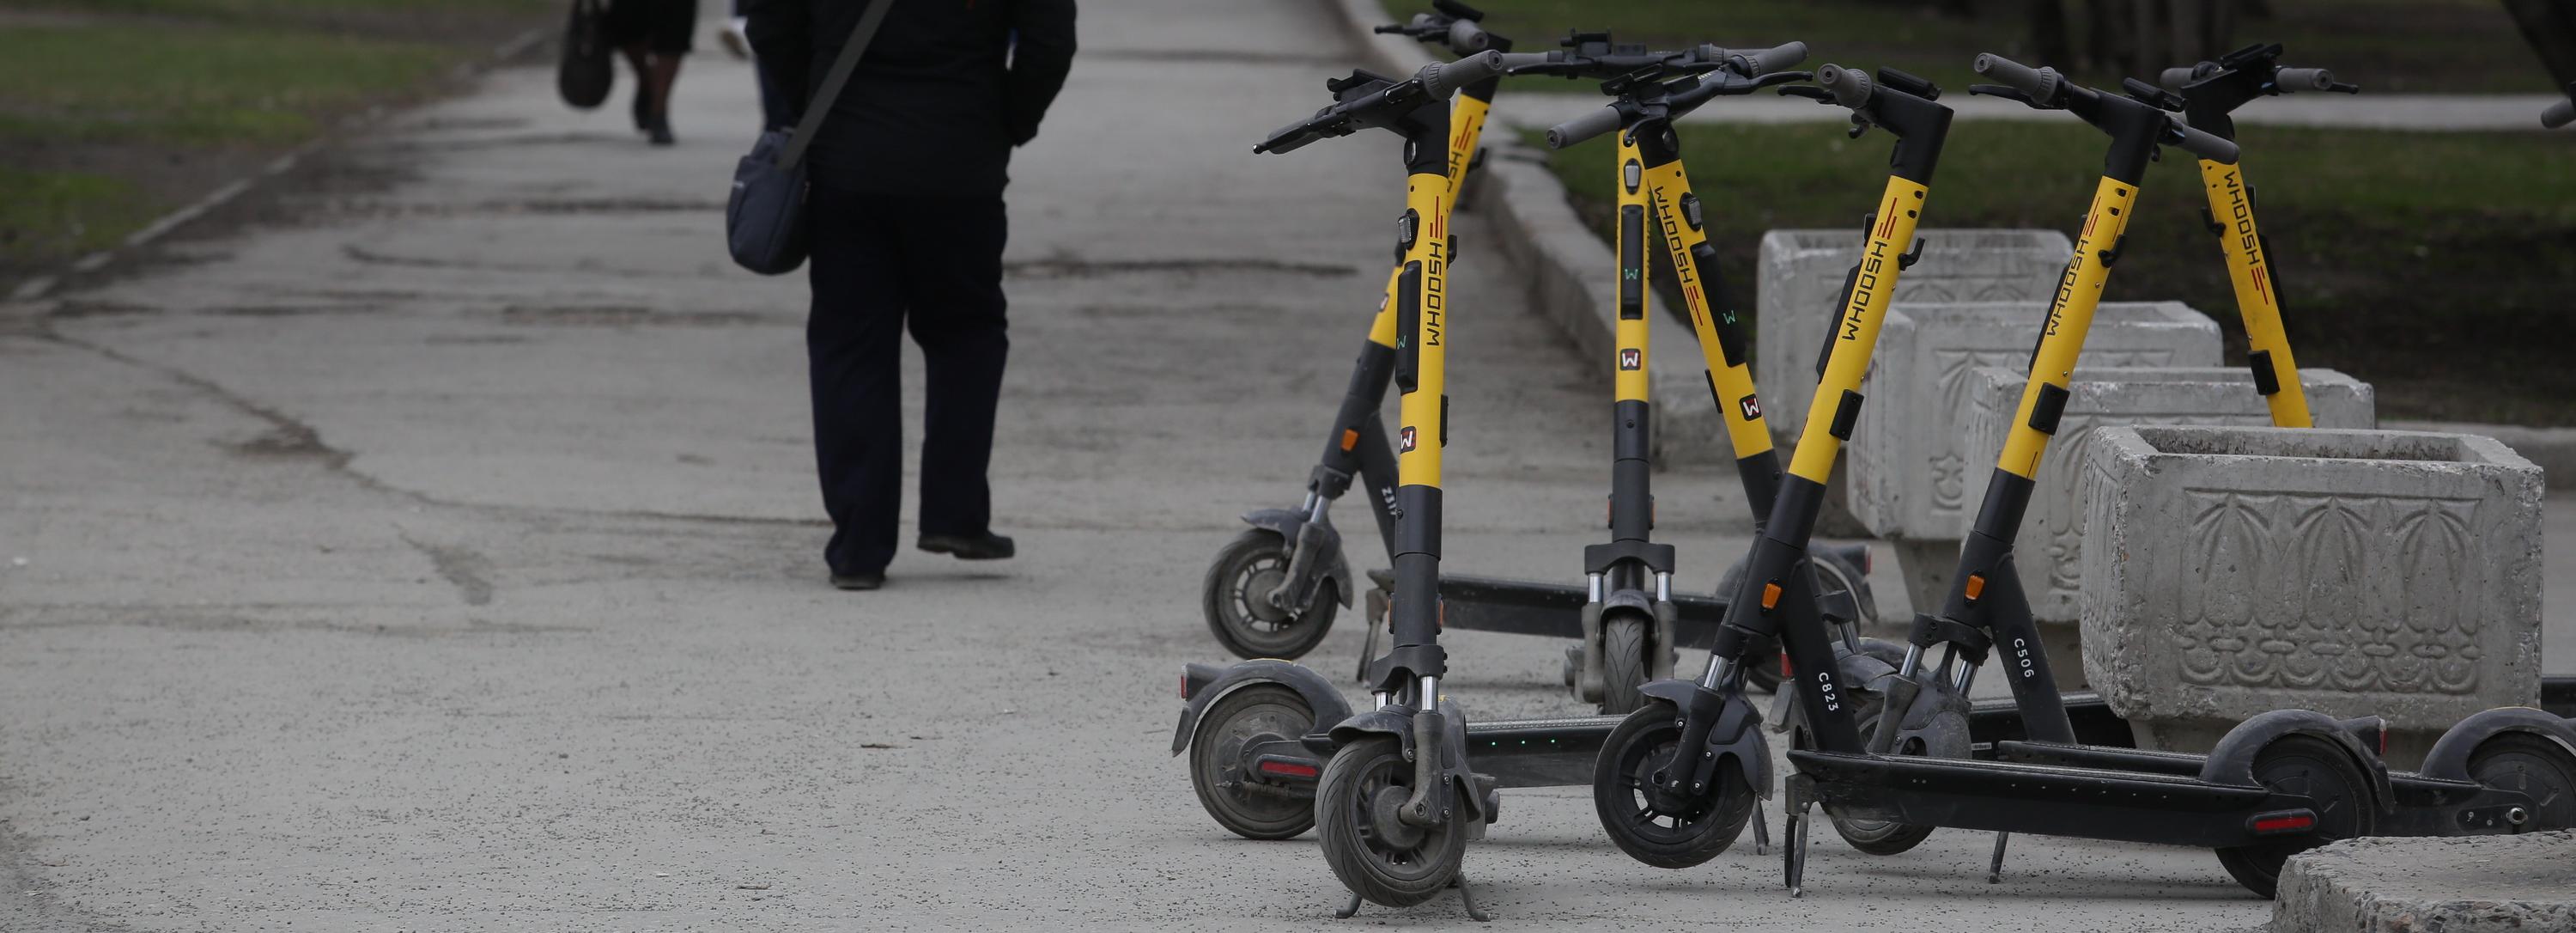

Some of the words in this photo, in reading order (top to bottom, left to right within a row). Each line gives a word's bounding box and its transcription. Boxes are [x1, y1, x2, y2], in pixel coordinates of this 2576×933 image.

[1654, 186, 1693, 284] WHOOSH
[2224, 171, 2261, 265] WHOOSH
[1426, 241, 1443, 346] WHOOSH
[1842, 241, 1888, 340] WHOOSH
[2047, 239, 2089, 336] WHOOSH
[1819, 672, 1838, 711] C823
[2014, 637, 2034, 678] C506
